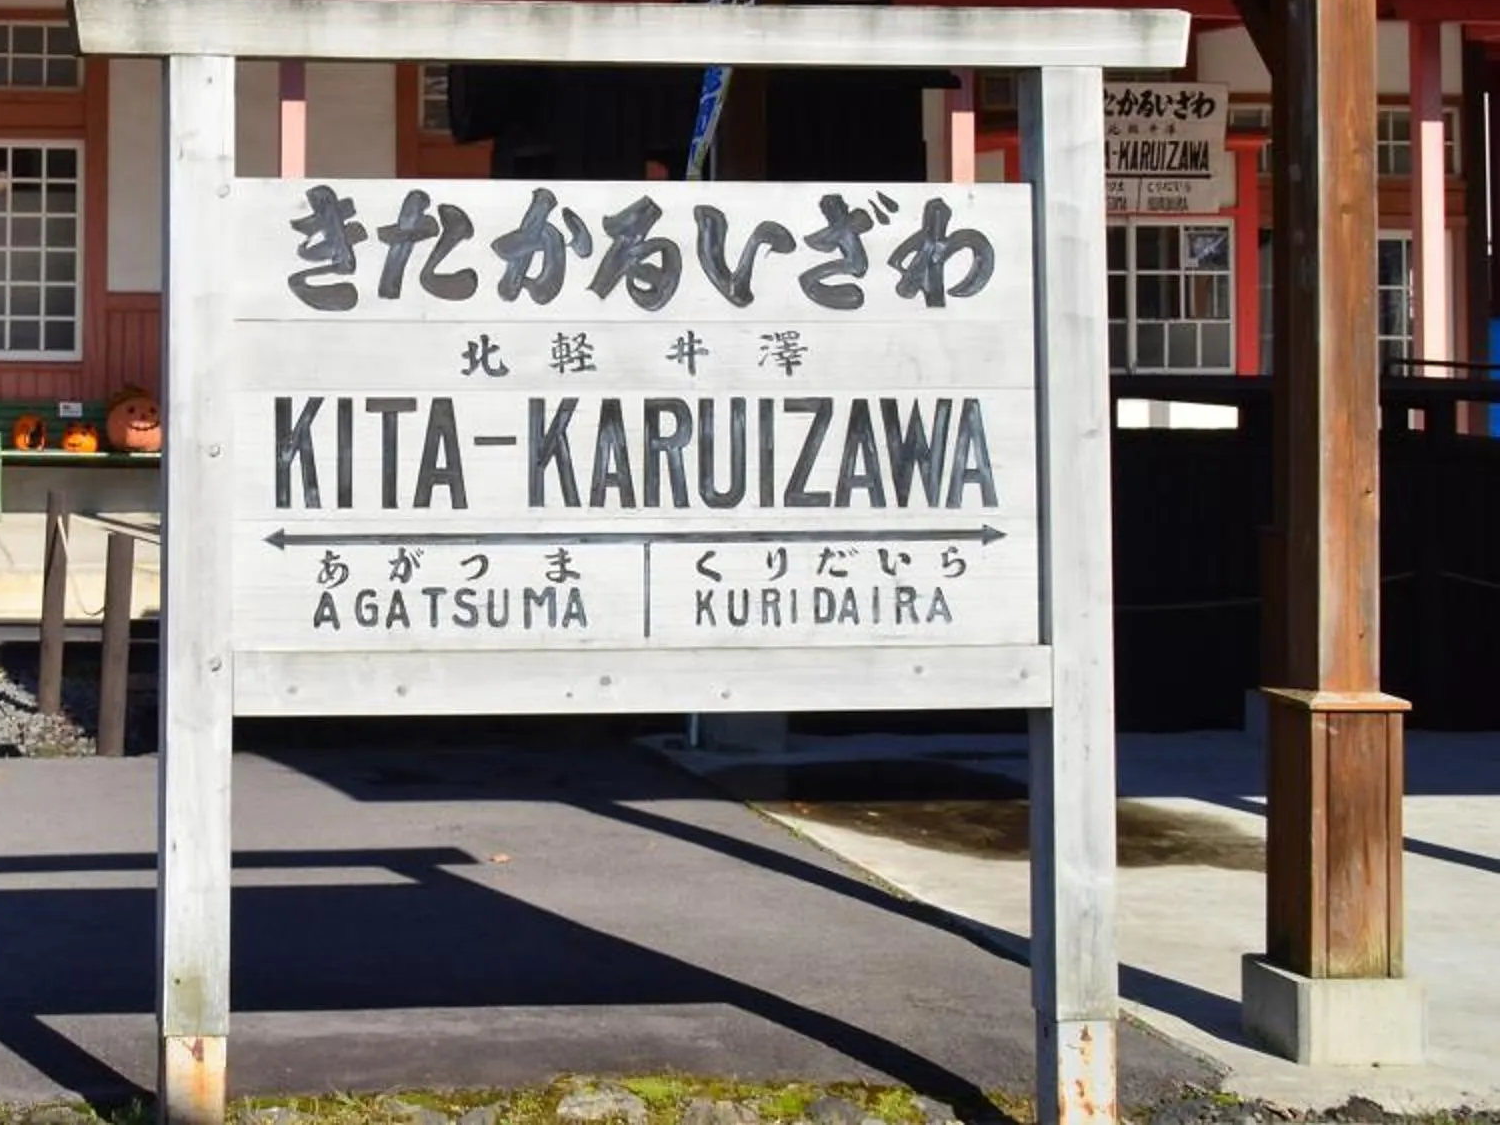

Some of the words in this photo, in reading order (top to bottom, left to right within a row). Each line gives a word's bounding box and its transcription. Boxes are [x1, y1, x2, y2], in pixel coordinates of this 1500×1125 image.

[288, 185, 995, 311] きたかるいざわ
[461, 330, 808, 377] 北軽井澤
[274, 396, 999, 510] KITA-KARUIZAWA
[317, 548, 581, 584] あがつま
[696, 547, 967, 581] くりだいら
[313, 586, 588, 630] AGATSUMA
[696, 586, 953, 627] KURIDAIRA
